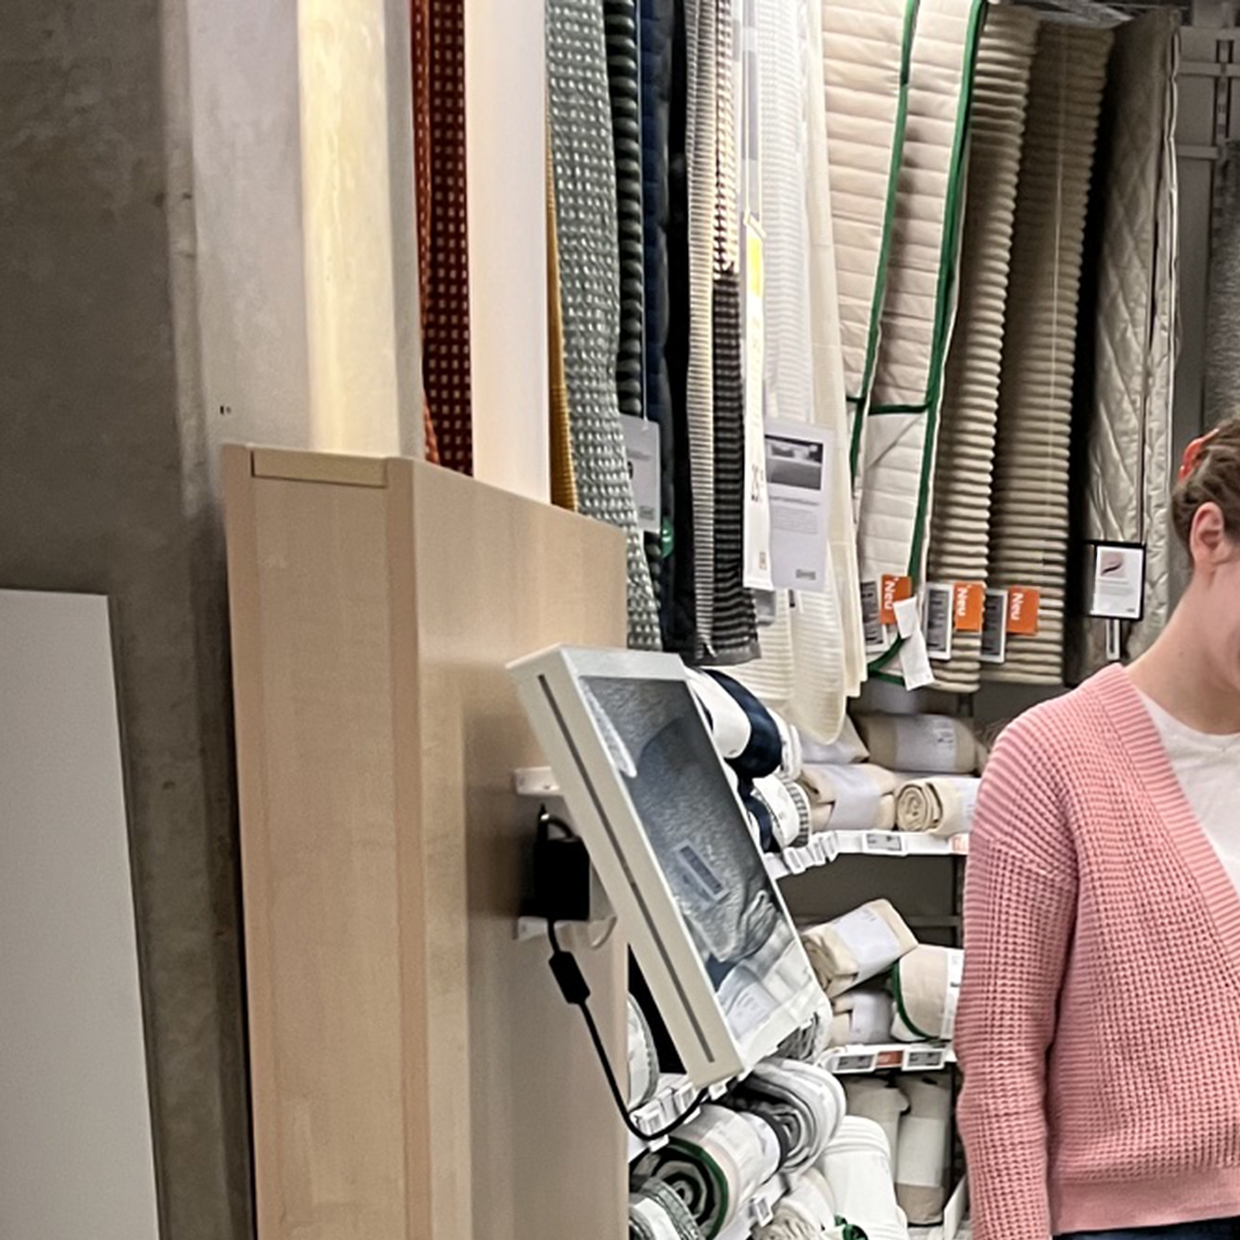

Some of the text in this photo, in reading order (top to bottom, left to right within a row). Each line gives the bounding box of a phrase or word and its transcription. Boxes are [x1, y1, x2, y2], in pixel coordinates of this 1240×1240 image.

[884, 580, 897, 610] Neu
[956, 586, 969, 617] Neu
[1010, 592, 1024, 621] Neu
